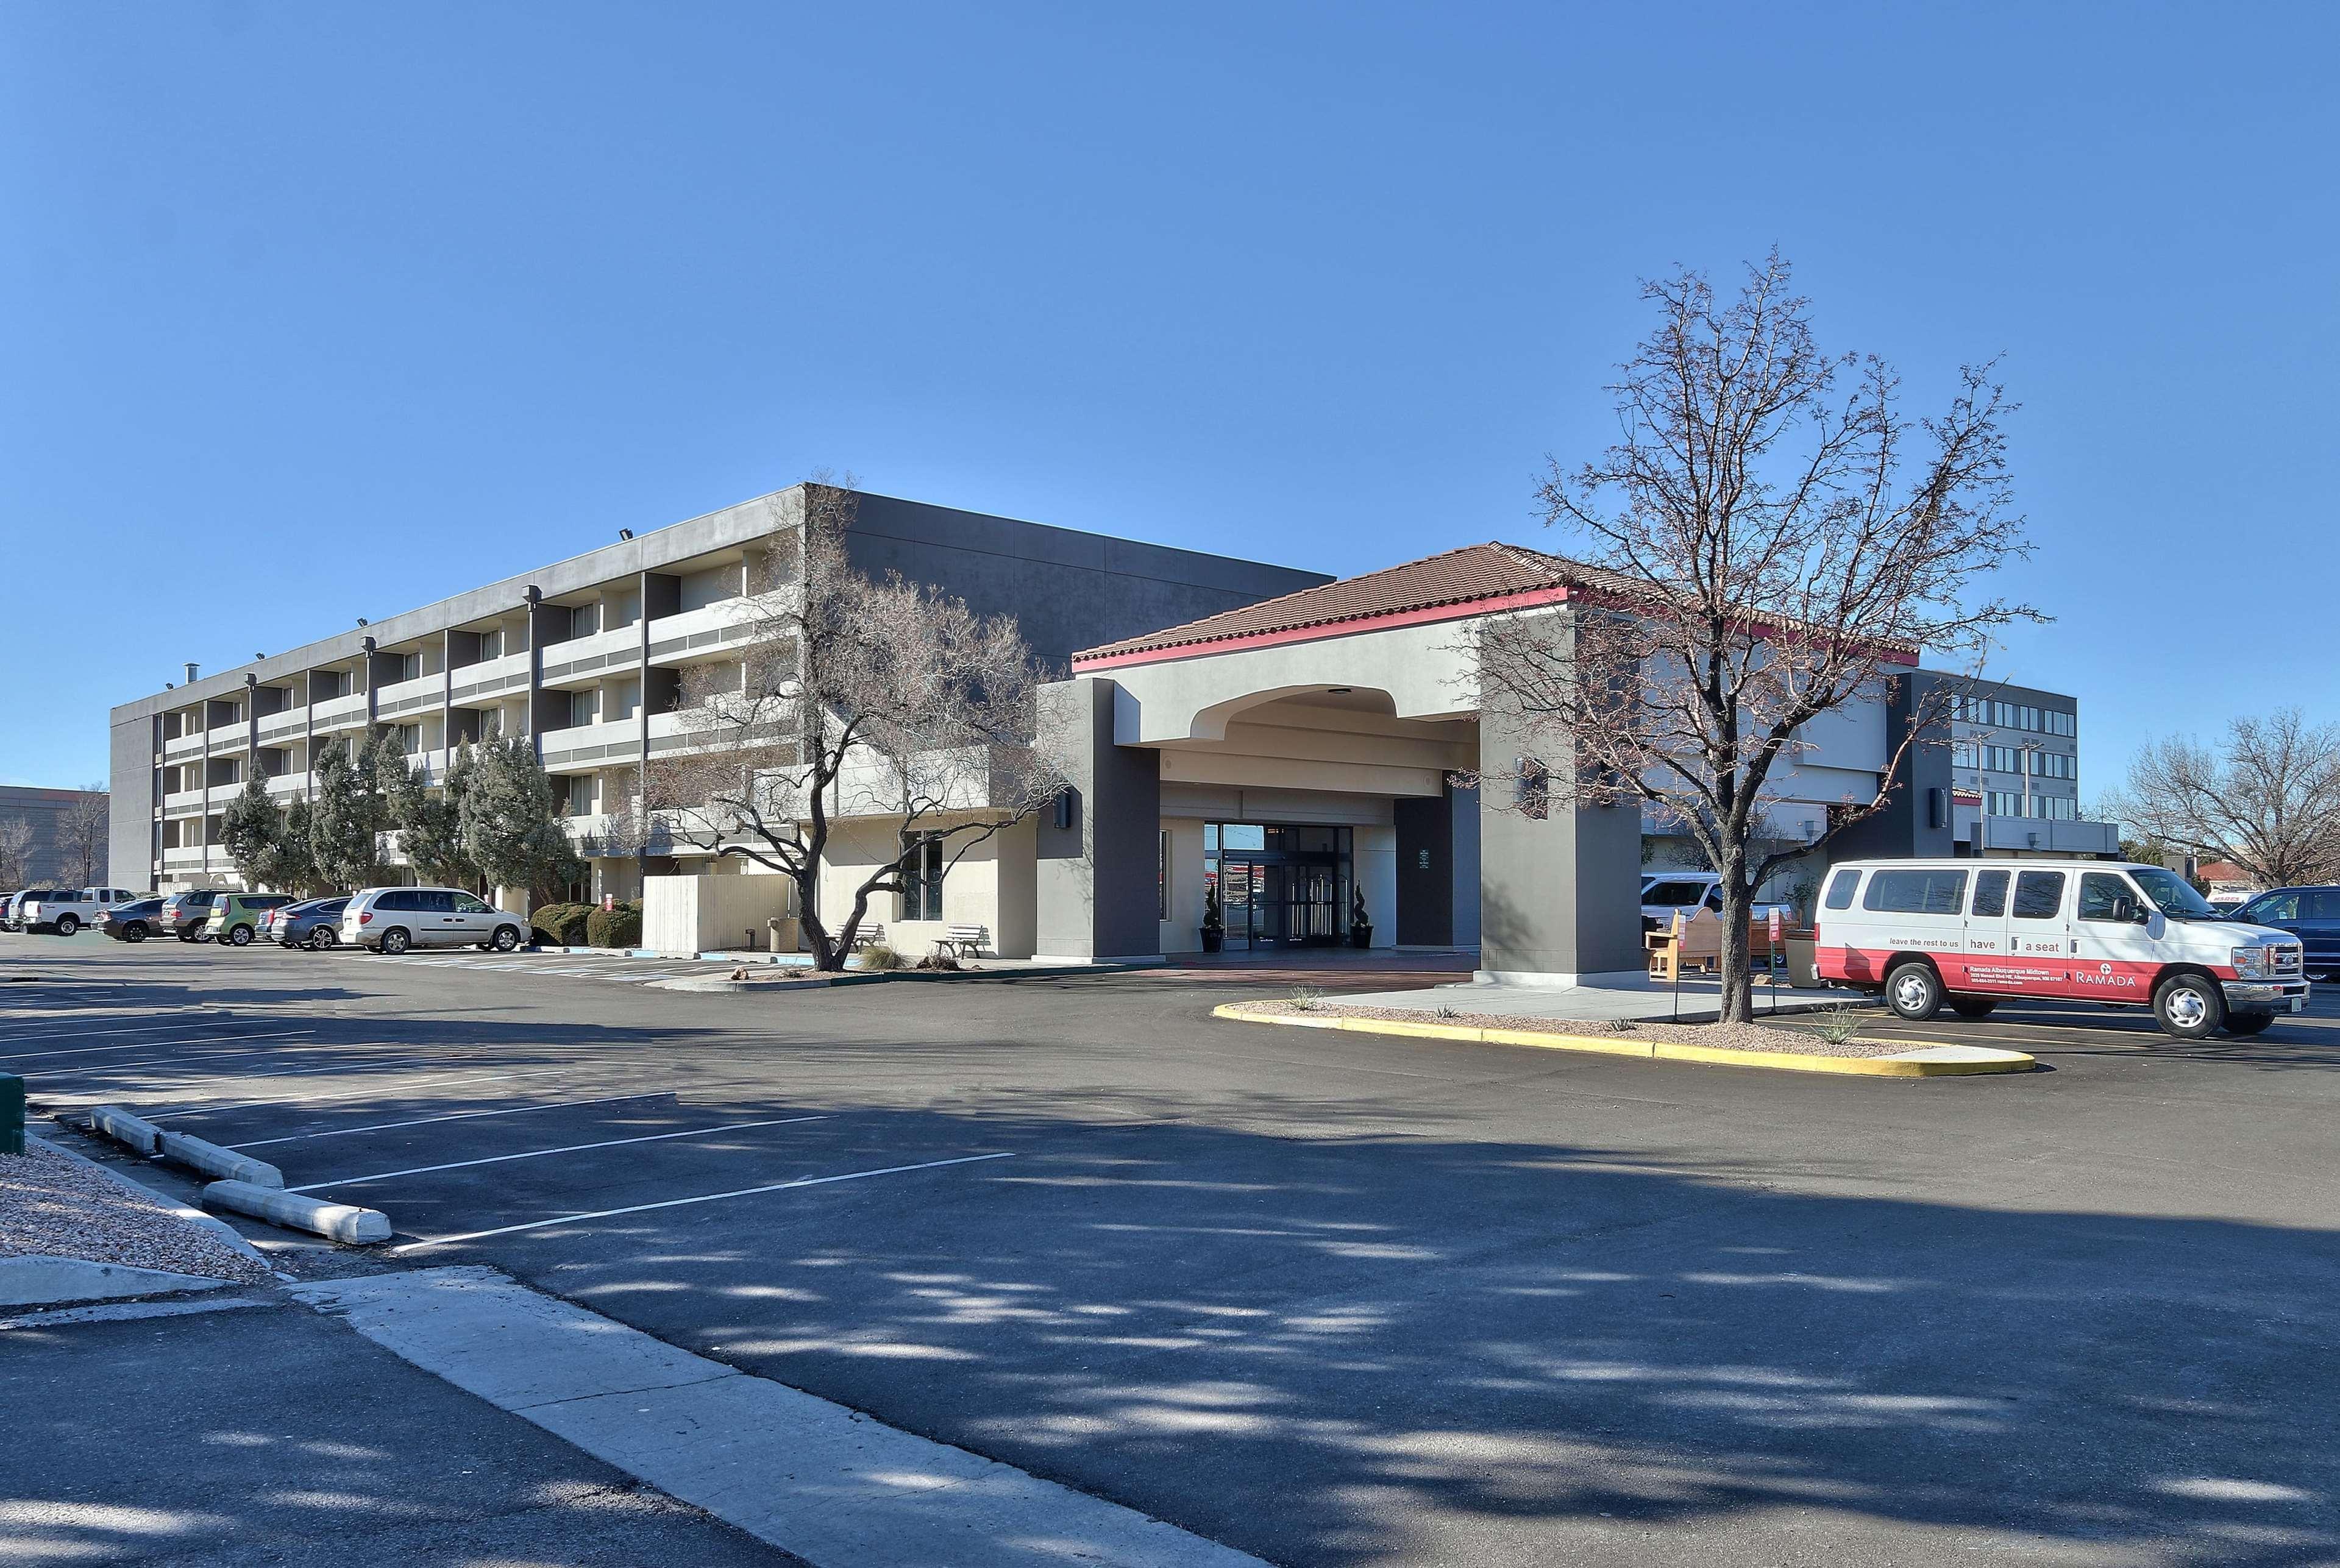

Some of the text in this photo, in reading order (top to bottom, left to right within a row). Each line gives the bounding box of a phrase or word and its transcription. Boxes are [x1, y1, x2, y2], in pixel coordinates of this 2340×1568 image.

[1971, 939, 1995, 949] have
[2035, 943, 2060, 952] seat
[1991, 967, 2025, 975] Albuquerque
[2076, 971, 2136, 987] RAMADA
